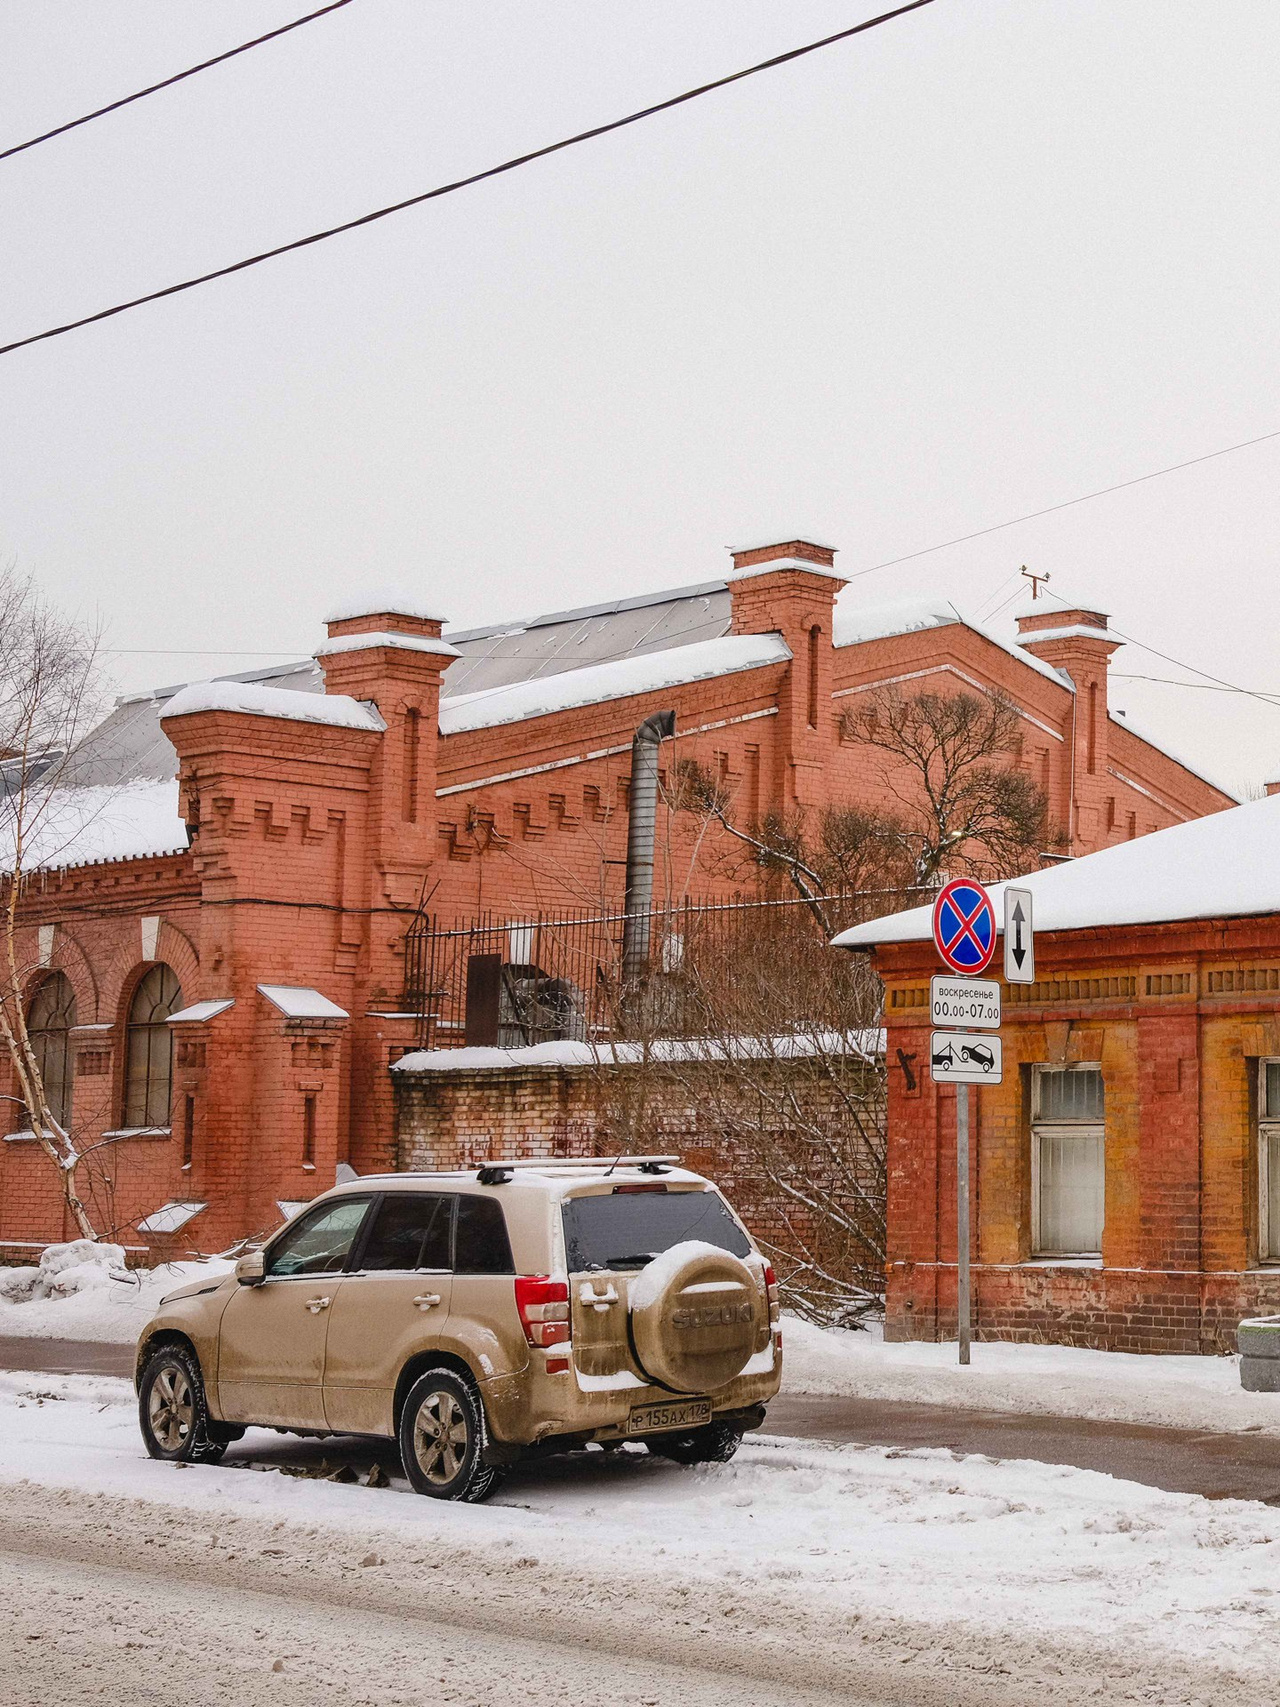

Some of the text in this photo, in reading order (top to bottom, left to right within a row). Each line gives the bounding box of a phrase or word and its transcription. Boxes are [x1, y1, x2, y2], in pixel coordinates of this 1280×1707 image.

[938, 986, 994, 1000] воскресенье
[934, 1001, 999, 1020] 00.00-07.00
[673, 1302, 754, 1329] SUZUKI
